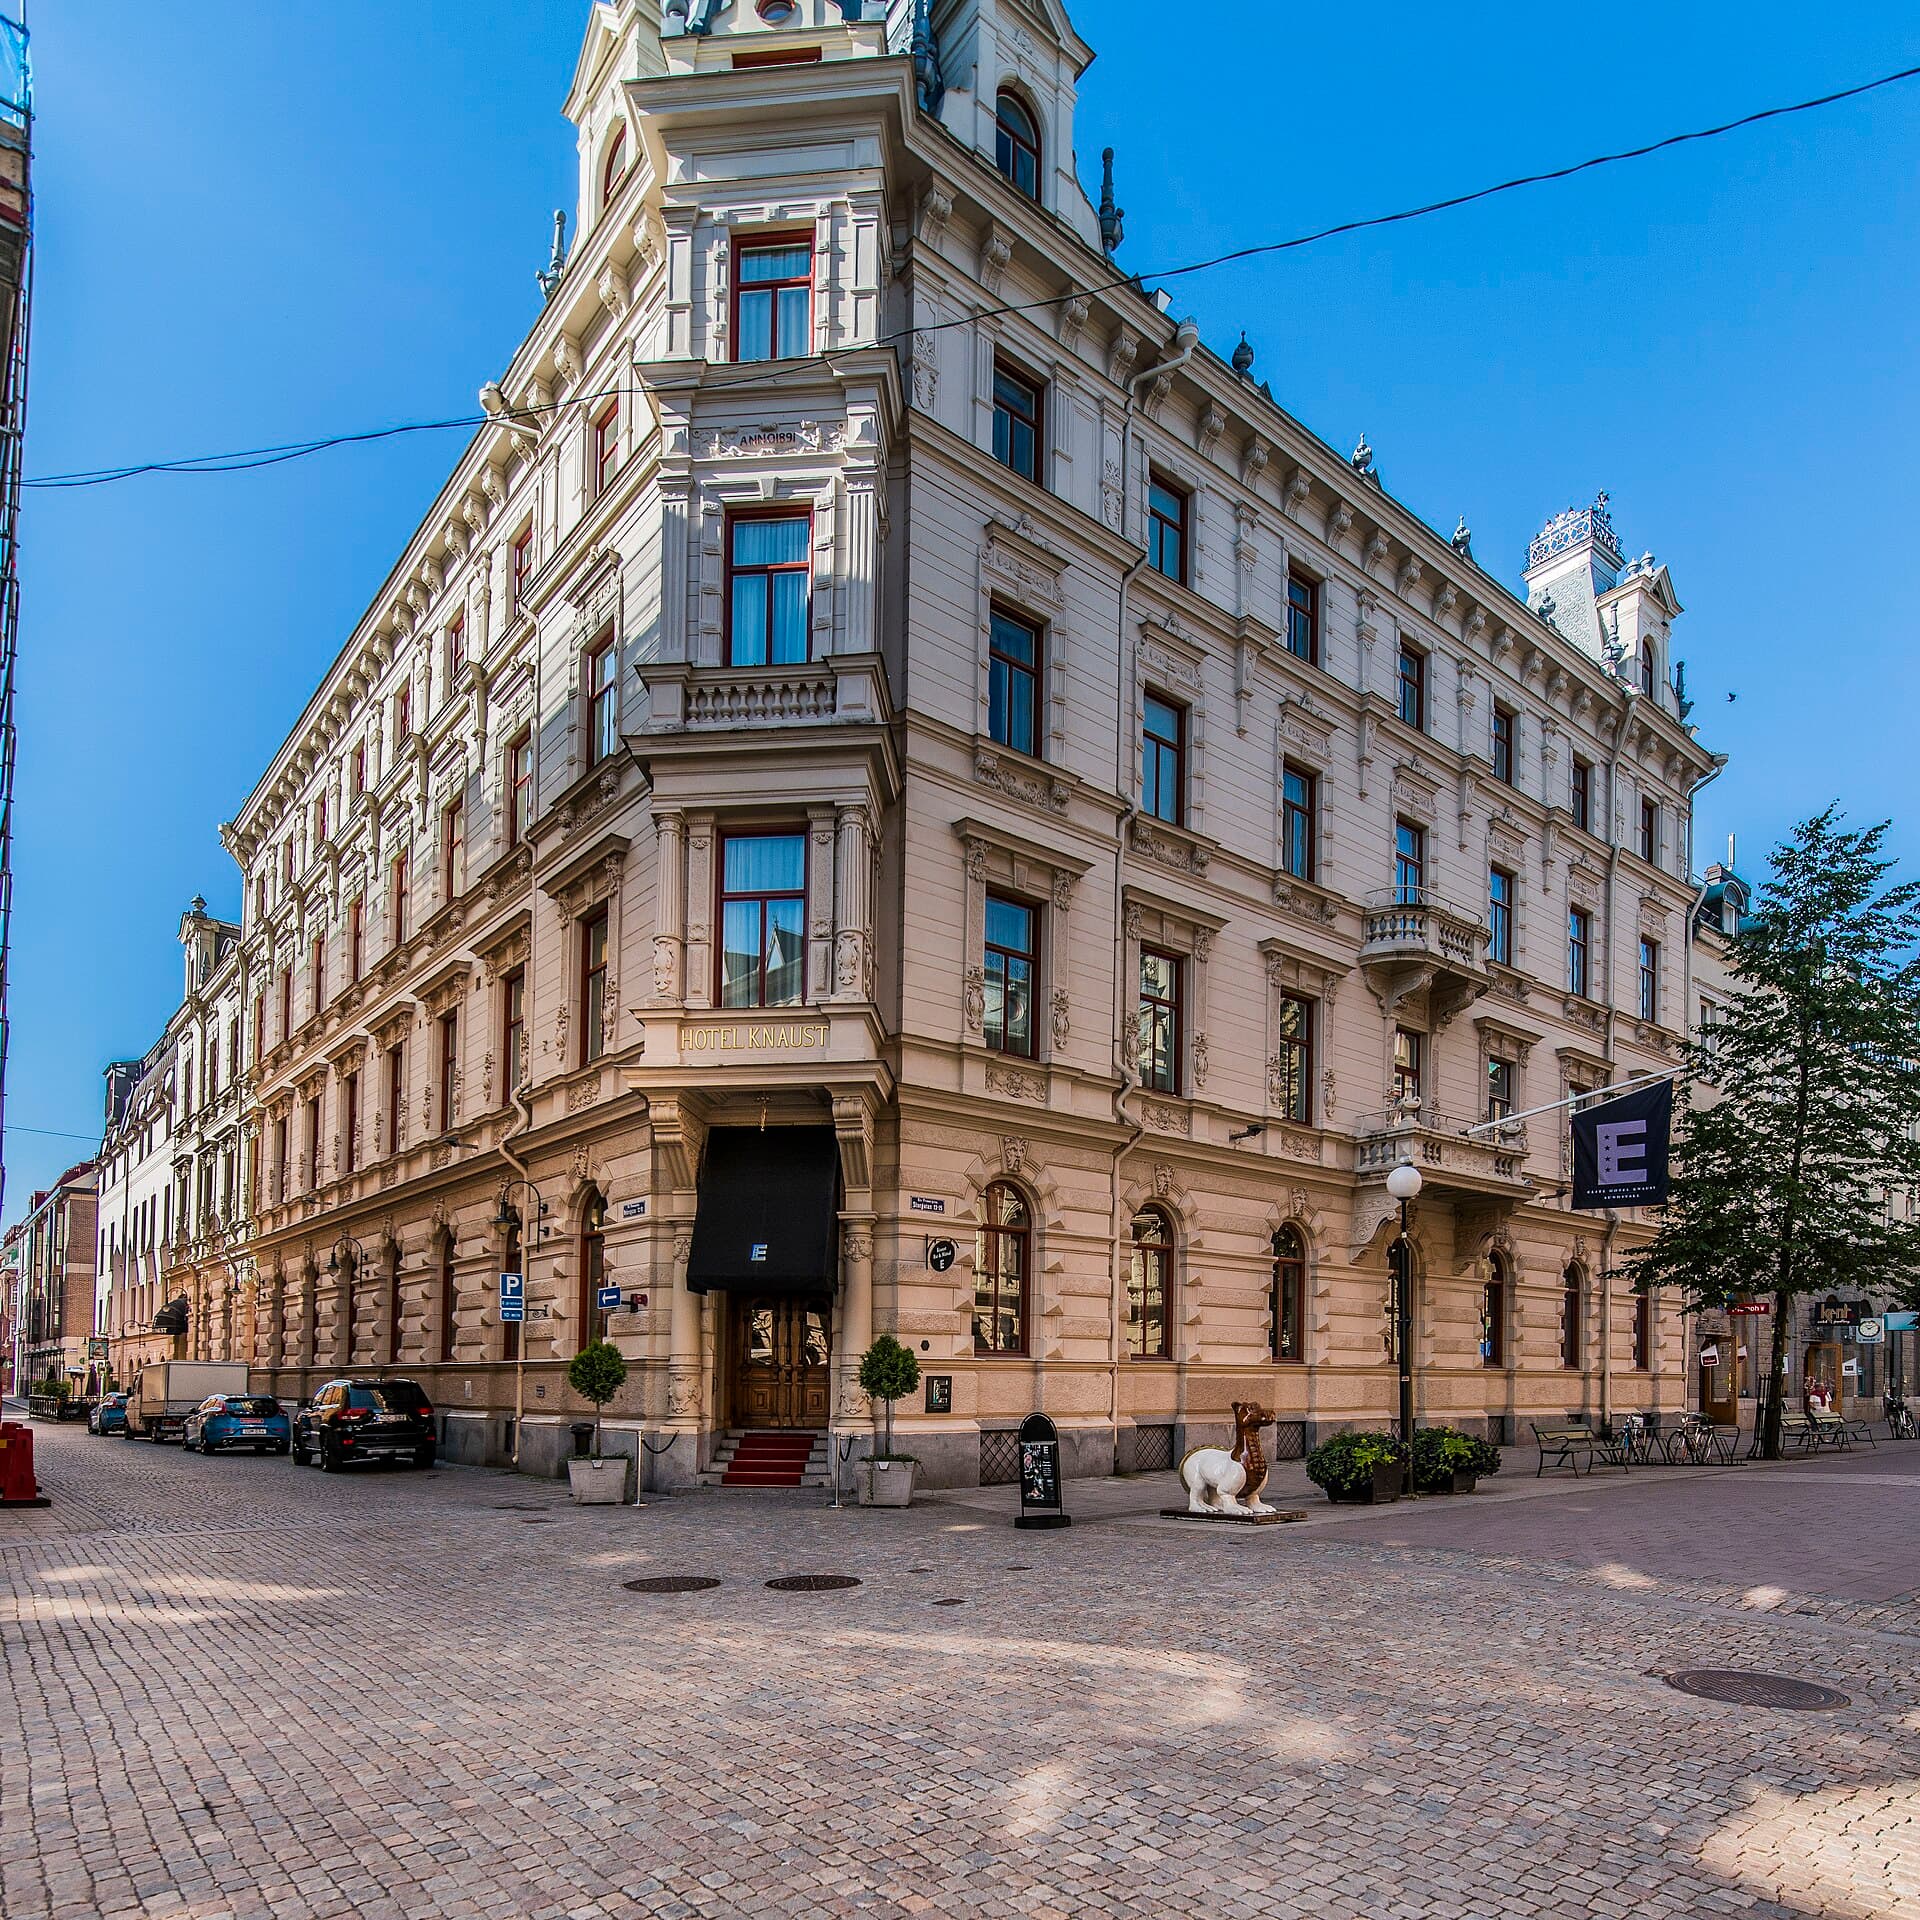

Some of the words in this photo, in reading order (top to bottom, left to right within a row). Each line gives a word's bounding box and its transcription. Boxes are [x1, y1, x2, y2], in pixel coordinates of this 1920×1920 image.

[681, 1028, 745, 1050] HOTEL
[748, 1025, 829, 1048] KNAUST
[1596, 1119, 1647, 1186] E
[751, 1244, 768, 1261] E
[507, 1276, 519, 1295] P
